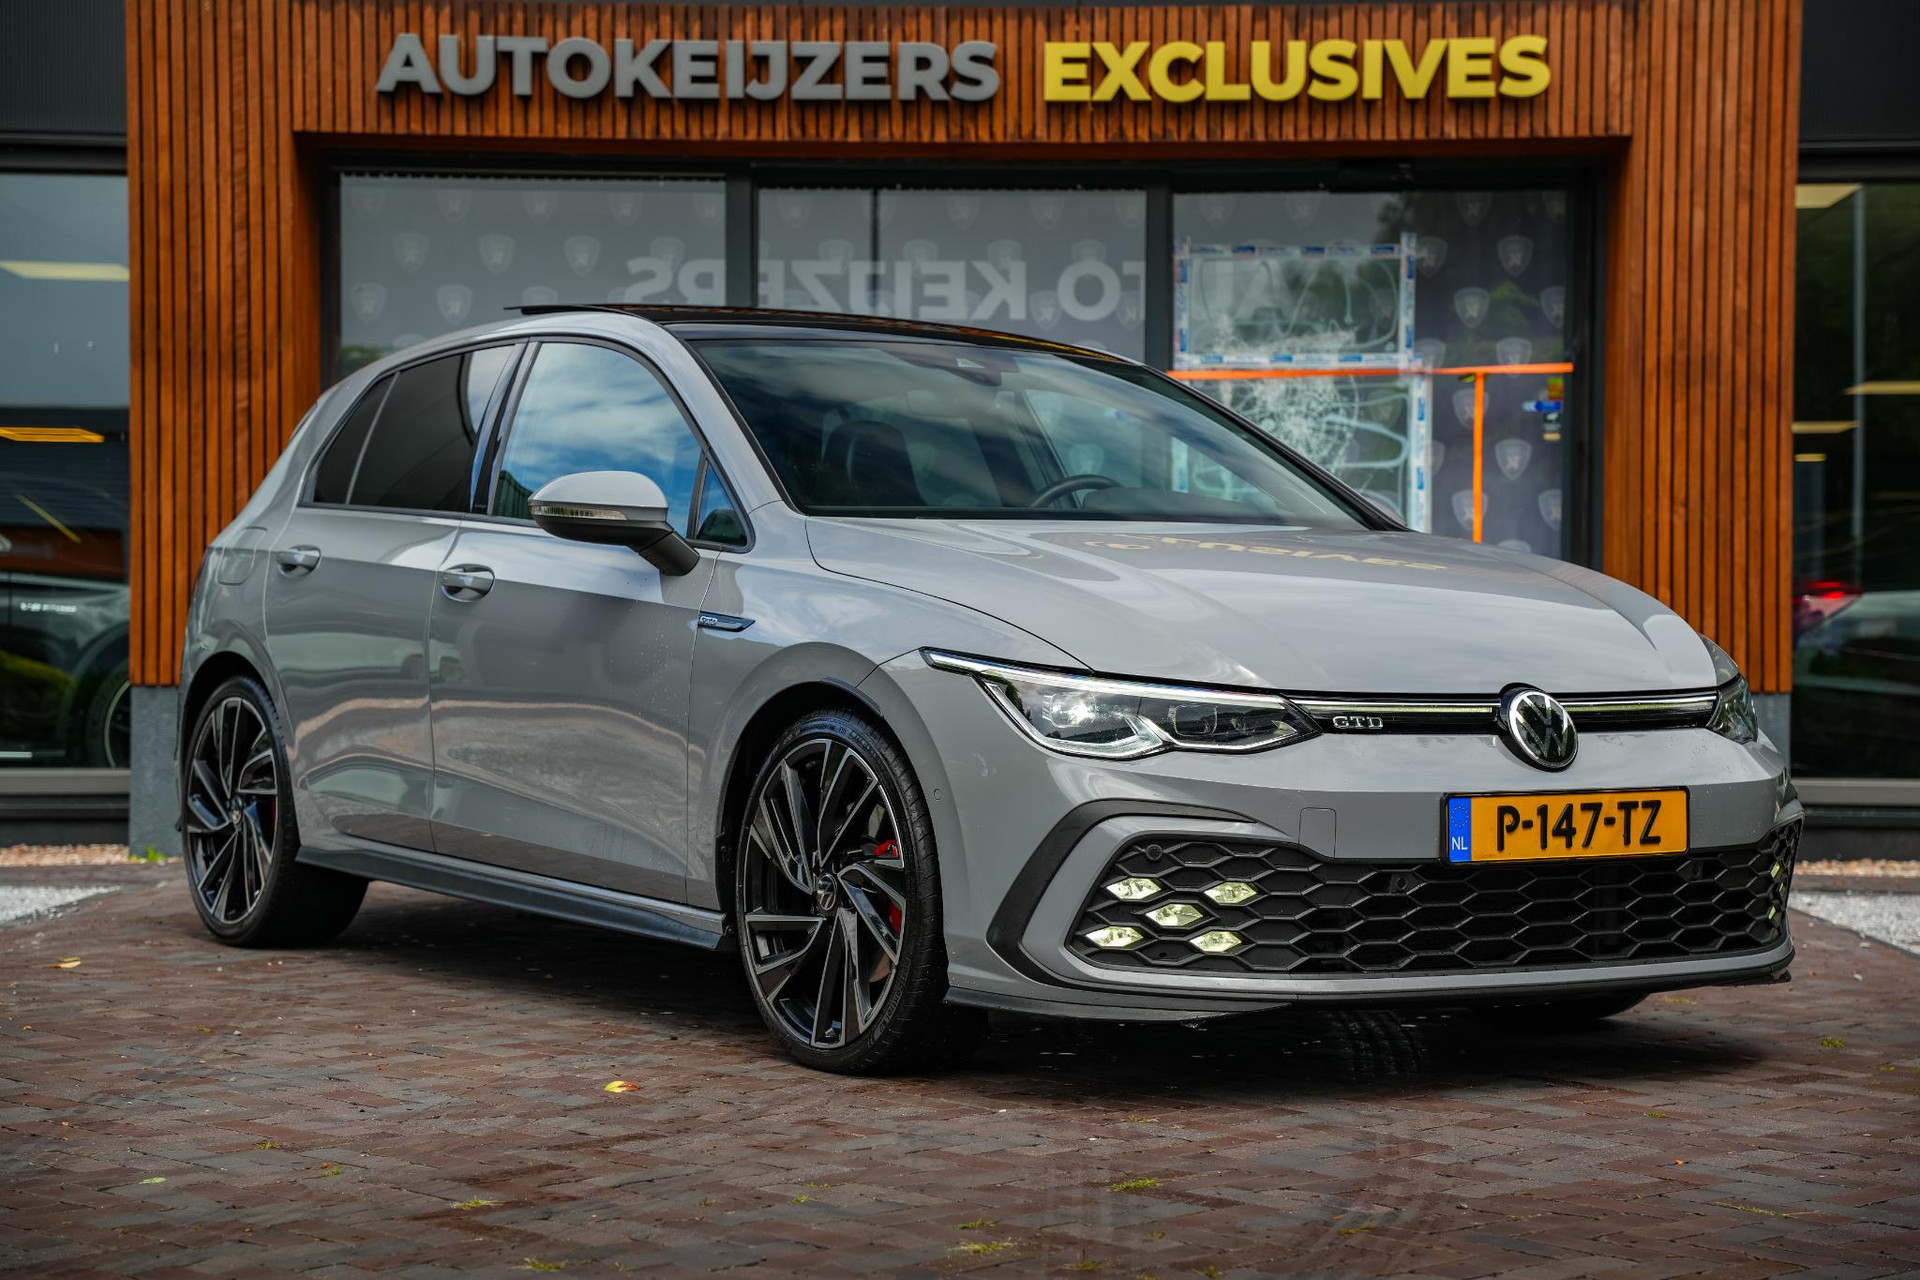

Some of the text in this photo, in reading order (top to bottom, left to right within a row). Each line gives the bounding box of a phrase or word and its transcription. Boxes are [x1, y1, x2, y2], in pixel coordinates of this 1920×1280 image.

[376, 33, 1551, 102] AUTOKEIJZERS EXCLUSIVES
[1332, 715, 1384, 730] GTD
[1497, 800, 1662, 851] P-147-TZ
[1451, 836, 1468, 851] NL
